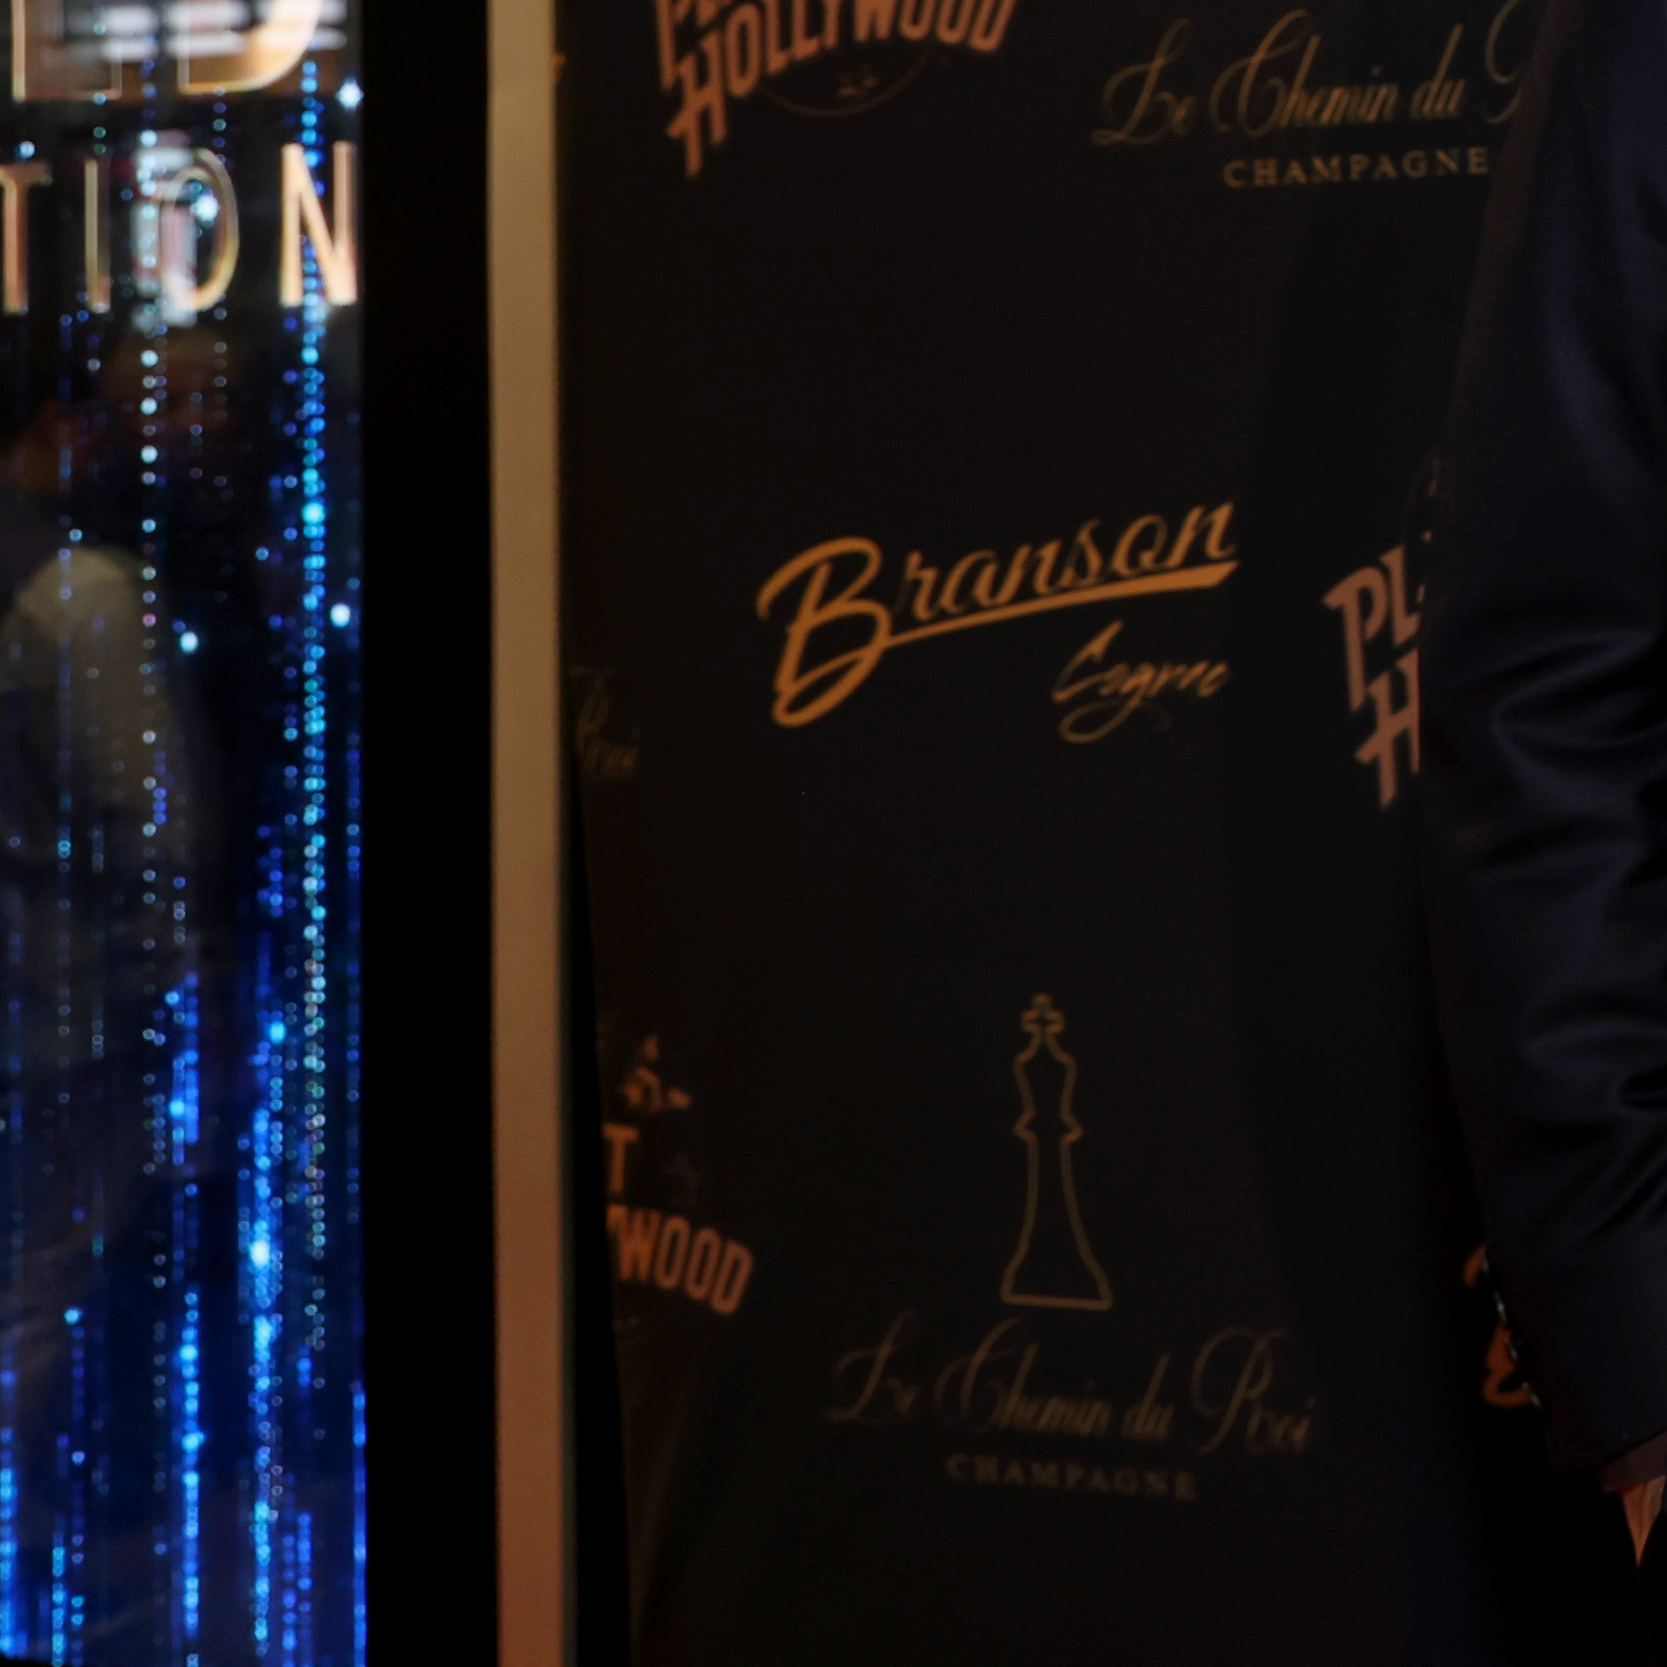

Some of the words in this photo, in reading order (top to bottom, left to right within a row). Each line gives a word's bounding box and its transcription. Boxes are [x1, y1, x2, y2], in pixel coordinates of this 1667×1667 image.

[1222, 146, 1490, 188] CHAMPAGNE
[756, 501, 1239, 728] Branson
[604, 1202, 755, 1315] WOOD
